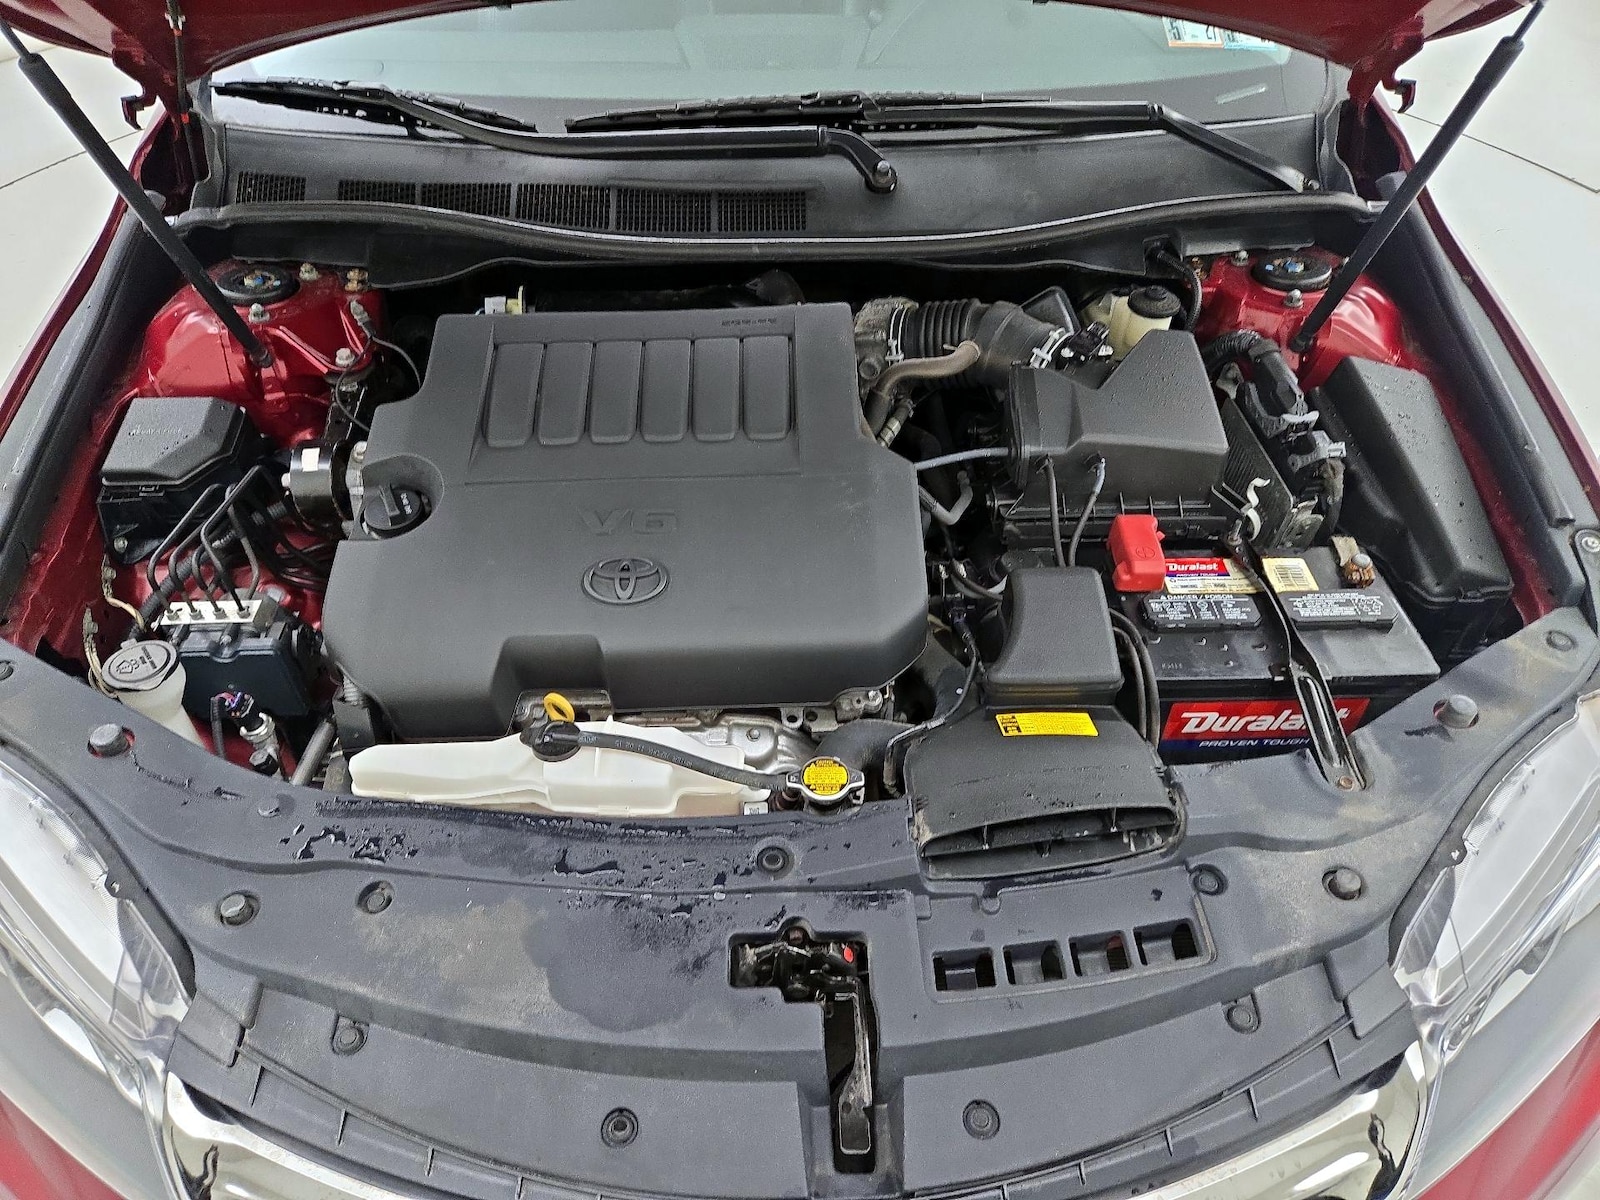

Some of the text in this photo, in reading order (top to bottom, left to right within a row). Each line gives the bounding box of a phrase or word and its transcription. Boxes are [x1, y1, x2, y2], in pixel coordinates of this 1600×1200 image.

[577, 508, 679, 537] V6
[1166, 563, 1218, 571] Duralast
[1199, 737, 1311, 748] PROVEN TOUGH
